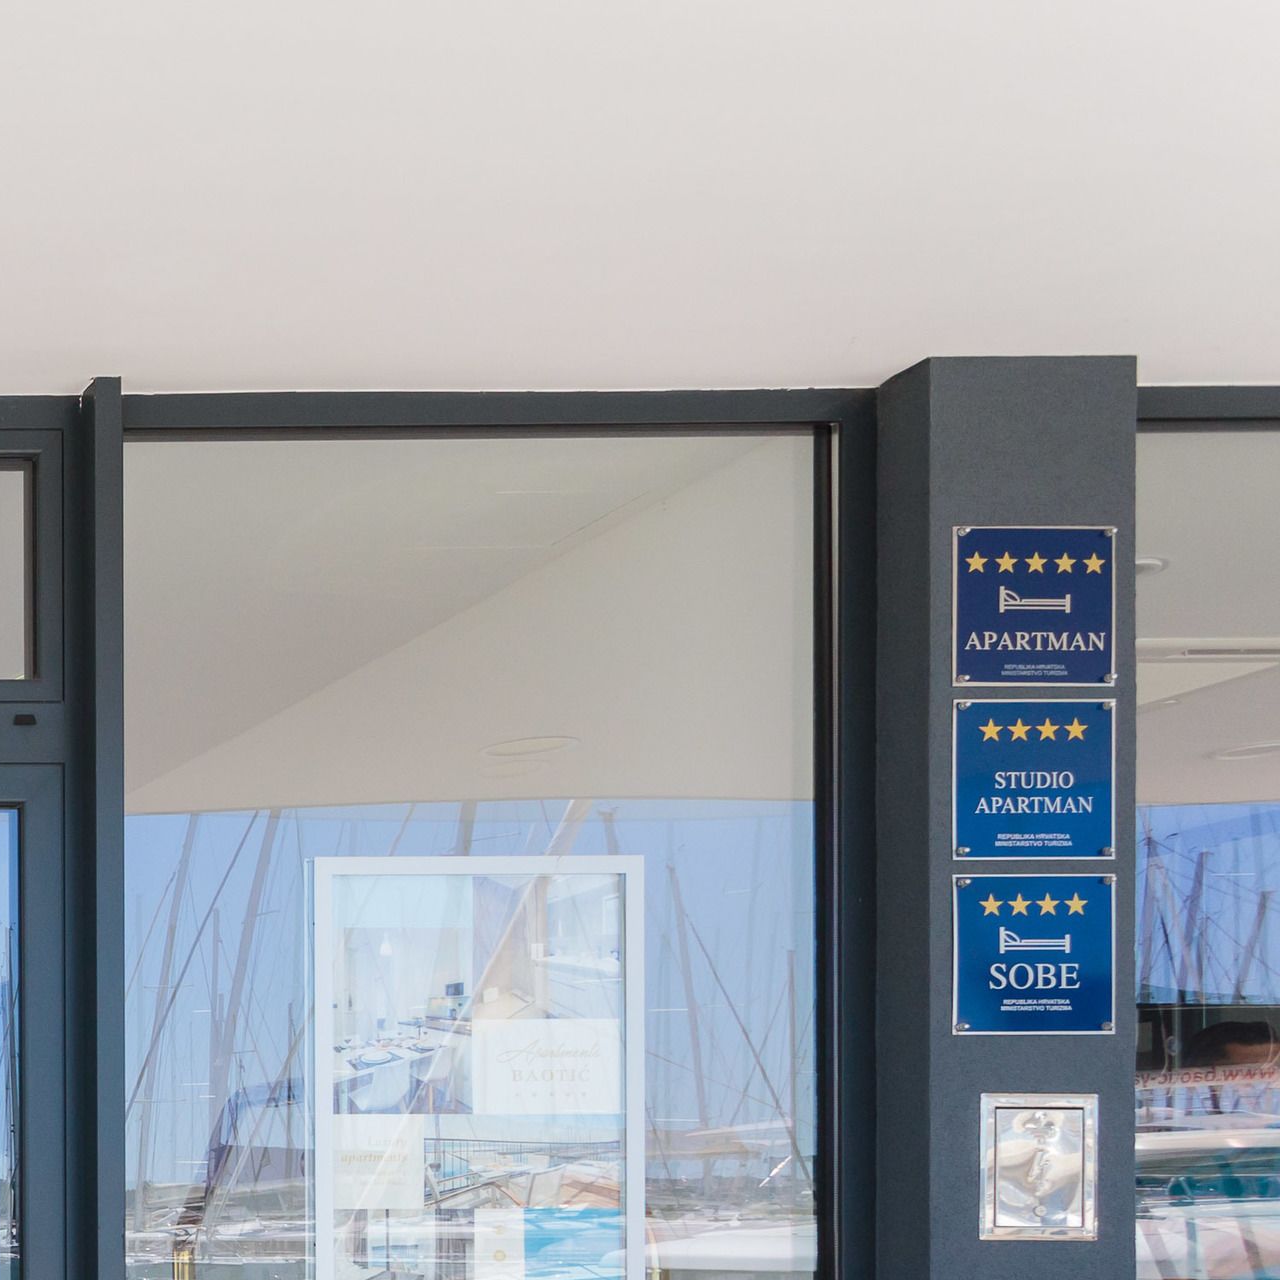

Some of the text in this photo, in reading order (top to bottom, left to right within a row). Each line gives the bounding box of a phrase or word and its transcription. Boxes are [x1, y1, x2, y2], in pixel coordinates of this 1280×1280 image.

[964, 631, 1106, 651] APARTMAN
[994, 771, 1075, 789] STUDIO
[974, 796, 1094, 814] APARTMAN
[989, 963, 1081, 990] SOBE
